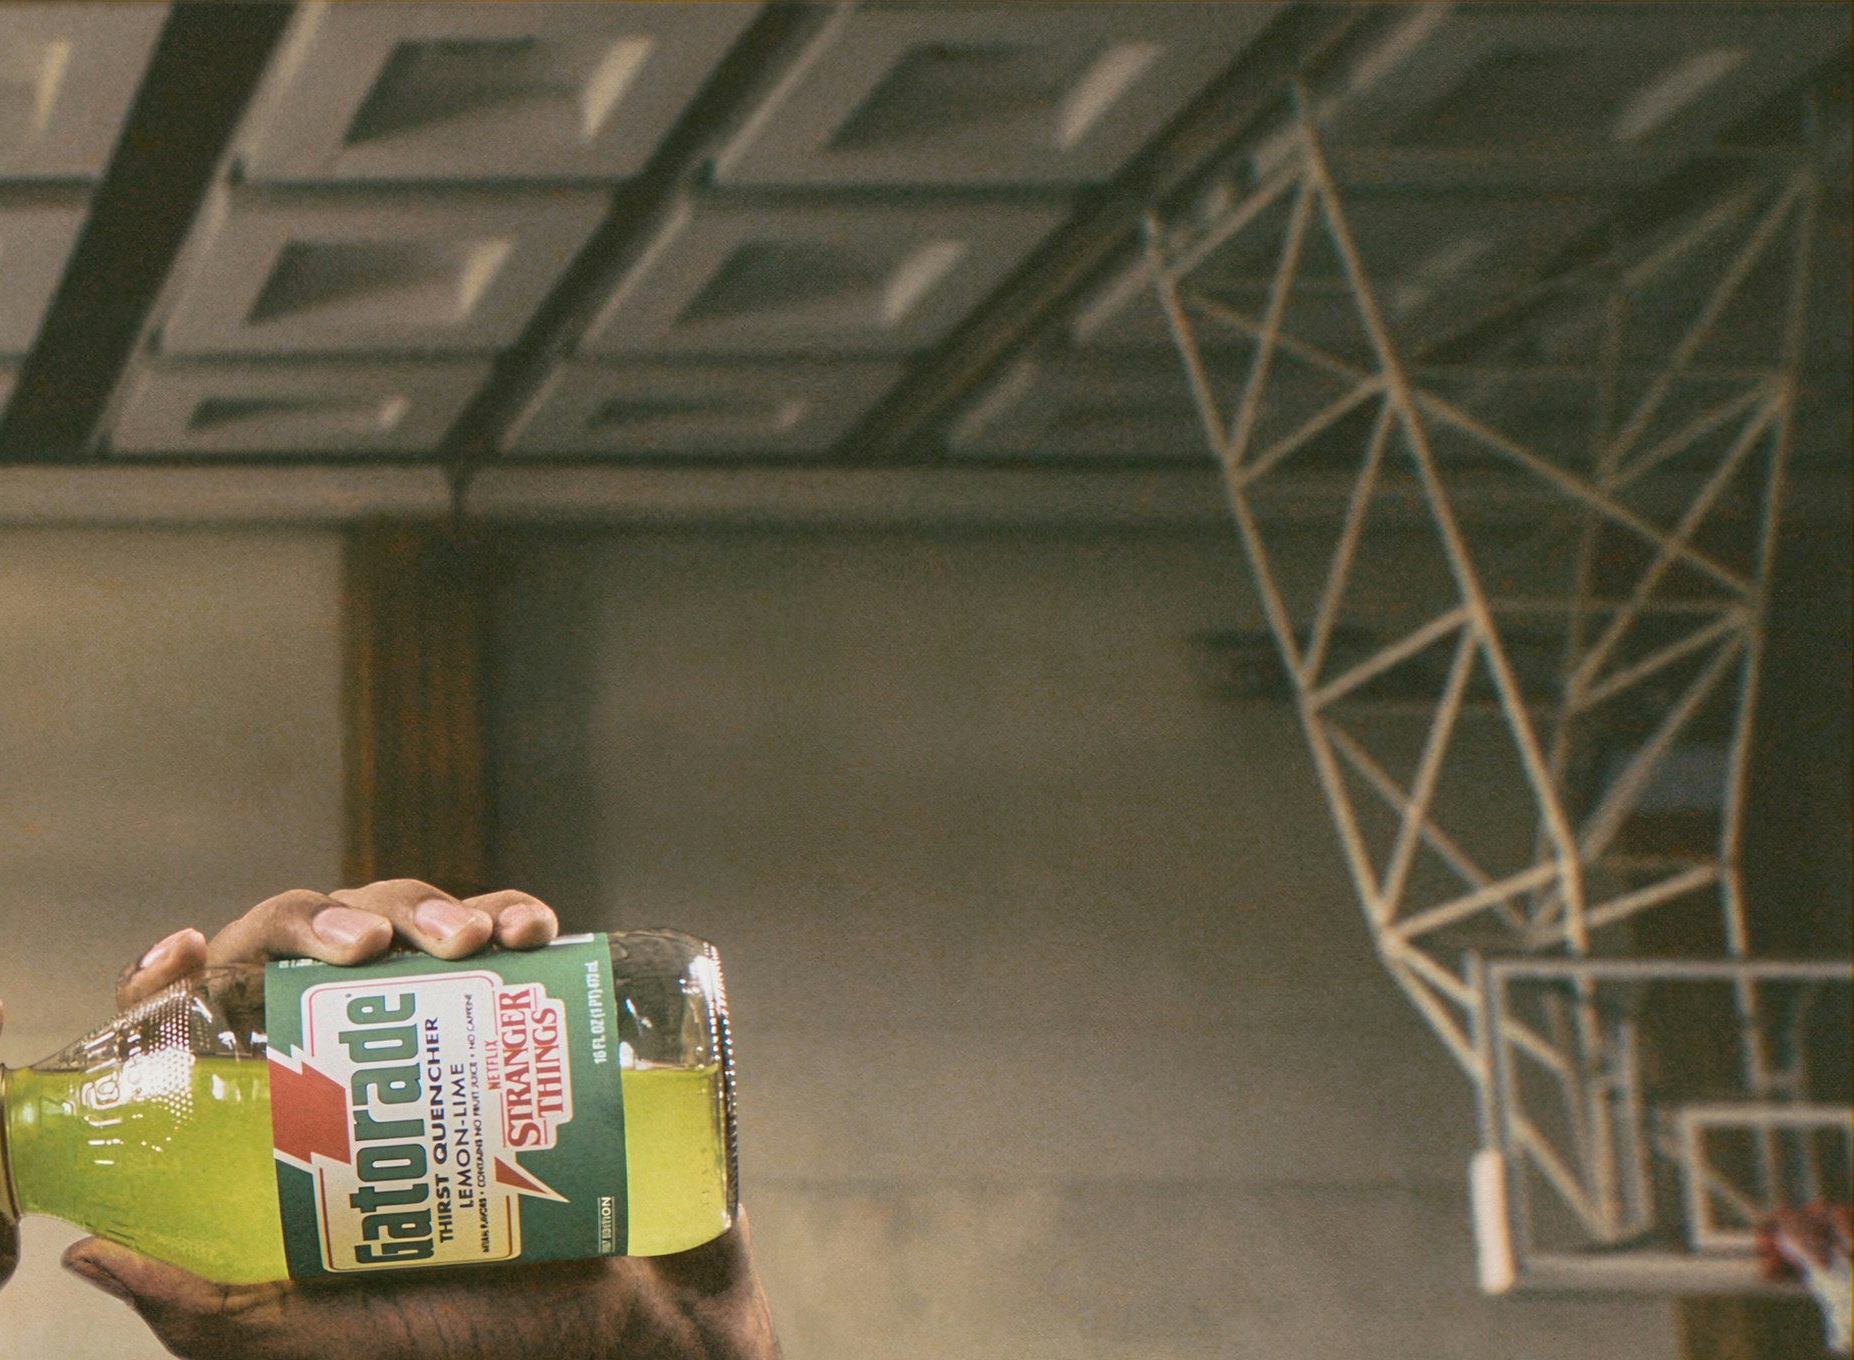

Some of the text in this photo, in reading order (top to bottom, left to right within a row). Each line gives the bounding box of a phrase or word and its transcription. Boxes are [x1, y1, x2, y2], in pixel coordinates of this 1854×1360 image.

[467, 1034, 475, 1049] NO
[590, 1019, 605, 1034] OZ
[469, 1062, 479, 1088] JUICE
[485, 1040, 501, 1091] NETFLIX
[499, 989, 541, 1147] STRANGER
[531, 1008, 563, 1118] THINGS
[593, 1051, 607, 1065] 16
[338, 992, 434, 1264] Gatorade
[471, 1091, 480, 1117] FRUIT
[474, 1119, 482, 1136] NO
[425, 1017, 454, 1243] THIRST QUENCHER
[450, 1063, 474, 1208] LEMON-LIME
[475, 1139, 485, 1188] CONTAINS
